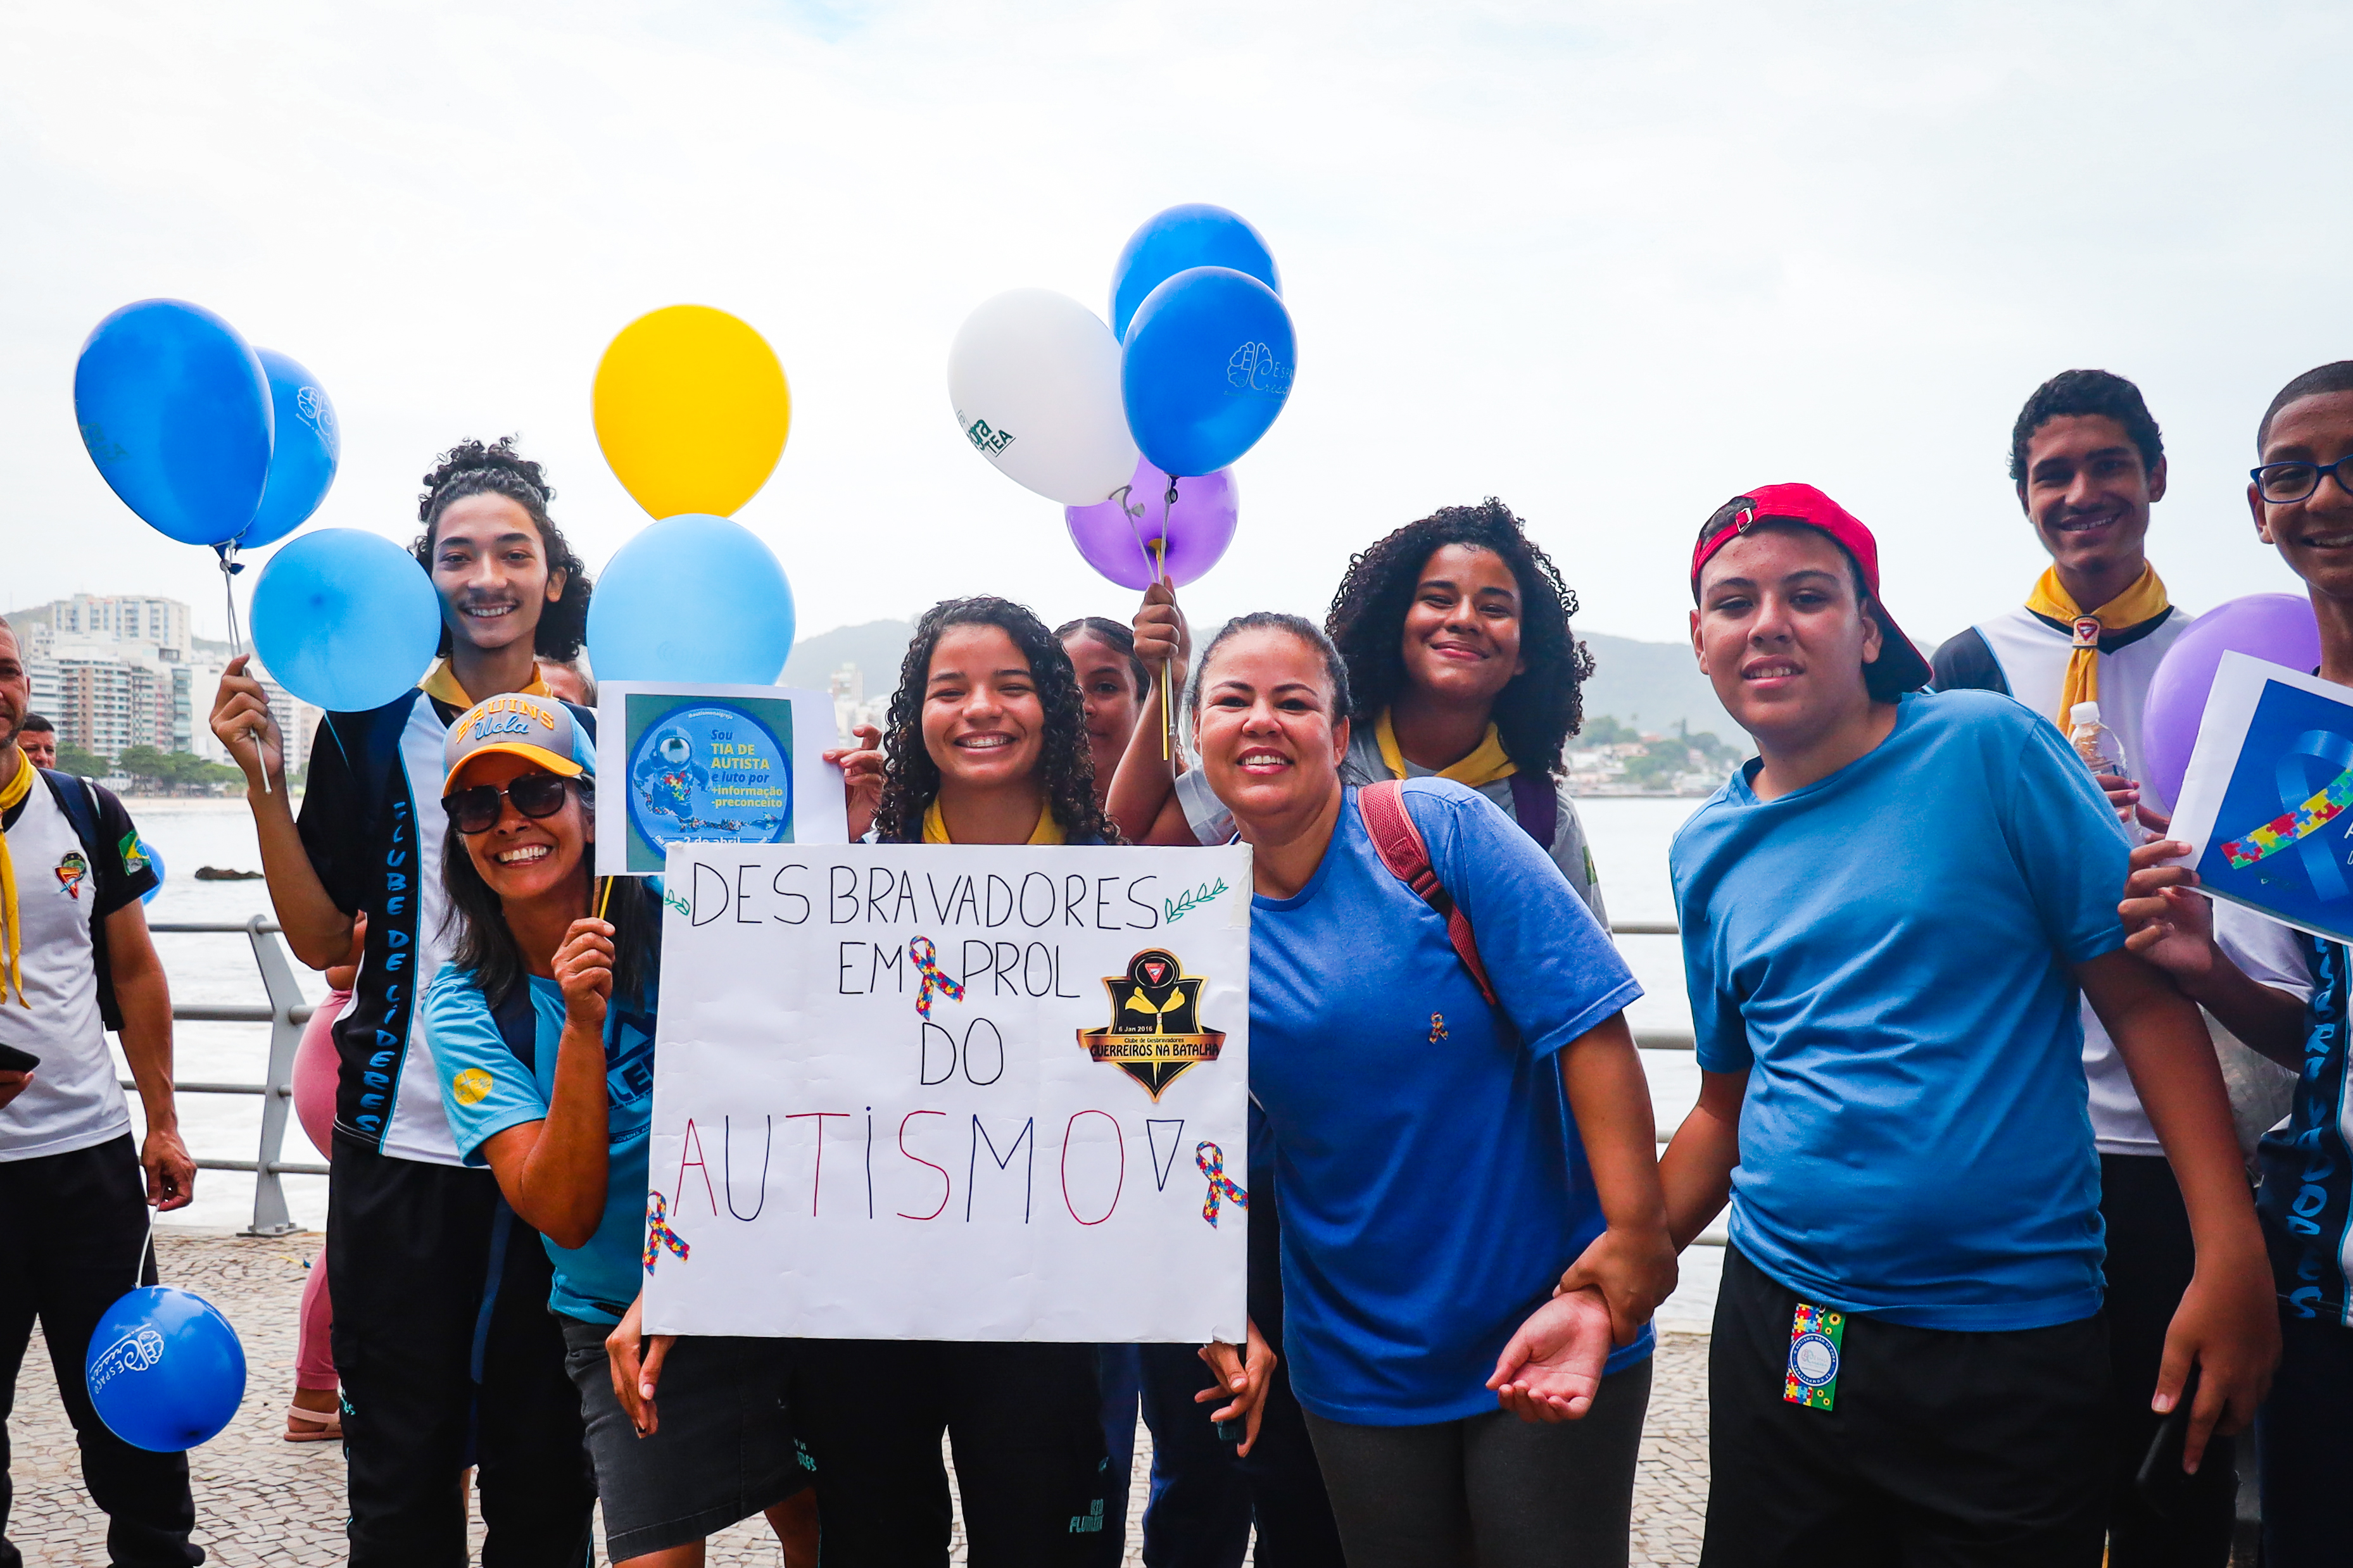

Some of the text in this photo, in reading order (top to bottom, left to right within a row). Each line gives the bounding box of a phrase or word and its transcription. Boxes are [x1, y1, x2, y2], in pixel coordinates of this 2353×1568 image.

[984, 429, 1014, 454] TEA
[455, 698, 555, 744] BRUINS
[711, 729, 733, 740] Sou
[710, 743, 755, 755] TIA DE
[710, 757, 770, 770] AUTISTA
[712, 772, 769, 786] e luto por
[712, 786, 783, 798] +informação
[711, 798, 783, 808] -preconceito
[386, 930, 410, 971] DE
[840, 940, 1080, 998] EM PROL
[921, 1018, 1003, 1086] DO
[1090, 1043, 1220, 1057] GUERREIROS NA BATALHA
